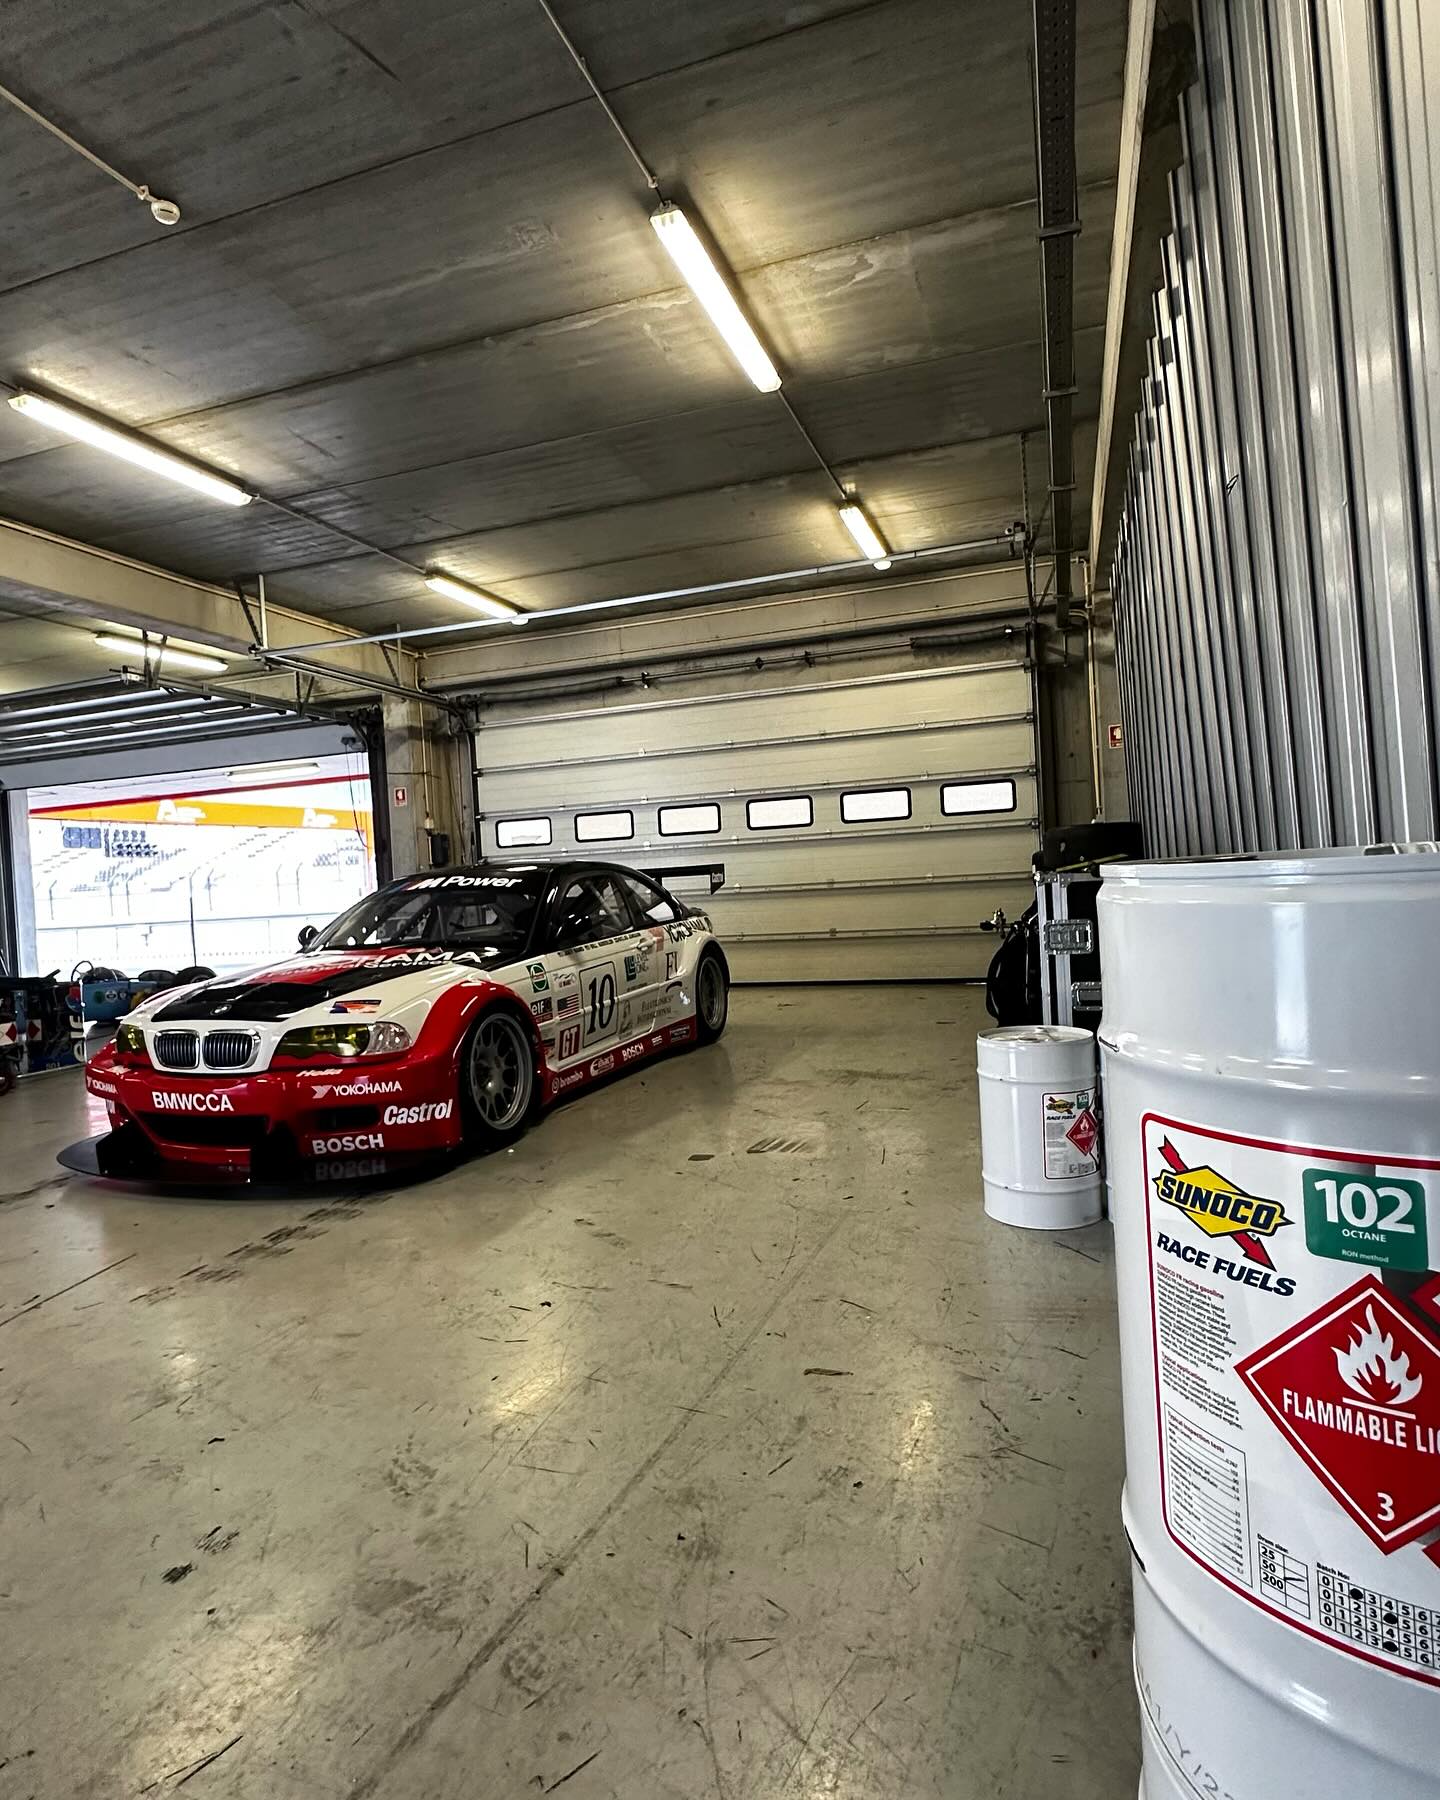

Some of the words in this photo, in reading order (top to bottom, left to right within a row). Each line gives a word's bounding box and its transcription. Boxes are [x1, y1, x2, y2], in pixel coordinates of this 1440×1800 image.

[441, 876, 522, 888] Power
[531, 1001, 544, 1016] elf
[587, 974, 615, 1035] 10
[562, 1028, 578, 1058] GT
[622, 1043, 644, 1061] BOSCH
[332, 1081, 402, 1096] YOKOHAMA
[560, 1071, 583, 1088] brembo
[152, 1091, 234, 1112] BMWCCA
[383, 1099, 453, 1126] Castrol
[312, 1133, 385, 1155] BOSCH
[1161, 1175, 1277, 1230] SUNOCO
[1314, 1179, 1416, 1234] 102
[1342, 1229, 1387, 1242] OCTANE
[1157, 1232, 1210, 1269] RACE
[1212, 1256, 1297, 1297] FUELS
[1342, 1249, 1358, 1258] RON
[1359, 1254, 1389, 1263] method
[1283, 1388, 1407, 1448] FLAMMABLE
[1415, 1425, 1440, 1455] LI
[1377, 1492, 1395, 1521] 3
[1257, 1533, 1274, 1546] Drum
[1261, 1546, 1275, 1559] 25
[1262, 1559, 1276, 1573] 50
[1317, 1562, 1336, 1576] Batch
[1263, 1571, 1283, 1590] 200
[1322, 1576, 1330, 1586] 0
[1338, 1583, 1343, 1592] 1
[1368, 1594, 1376, 1604] 3
[1385, 1601, 1393, 1610] 4
[1402, 1605, 1410, 1615] 5
[1418, 1611, 1427, 1621] 6
[1323, 1589, 1330, 1599] 0
[1339, 1596, 1344, 1605] 1
[1354, 1602, 1361, 1612] 2
[1369, 1608, 1377, 1618] 3
[1402, 1619, 1410, 1630] 5
[1419, 1625, 1428, 1635] 6
[1324, 1603, 1331, 1613] 0
[1339, 1609, 1345, 1619] 1
[1354, 1615, 1362, 1626] 2
[1370, 1622, 1378, 1632] 3
[1386, 1628, 1394, 1638] 4
[1403, 1633, 1411, 1644] 5
[1420, 1640, 1429, 1650] 6
[1325, 1616, 1332, 1626] 0
[1340, 1623, 1346, 1633] 1
[1355, 1629, 1363, 1640] 2
[1371, 1635, 1379, 1646] 3
[1403, 1648, 1412, 1658] 5
[1420, 1653, 1429, 1663] 6
